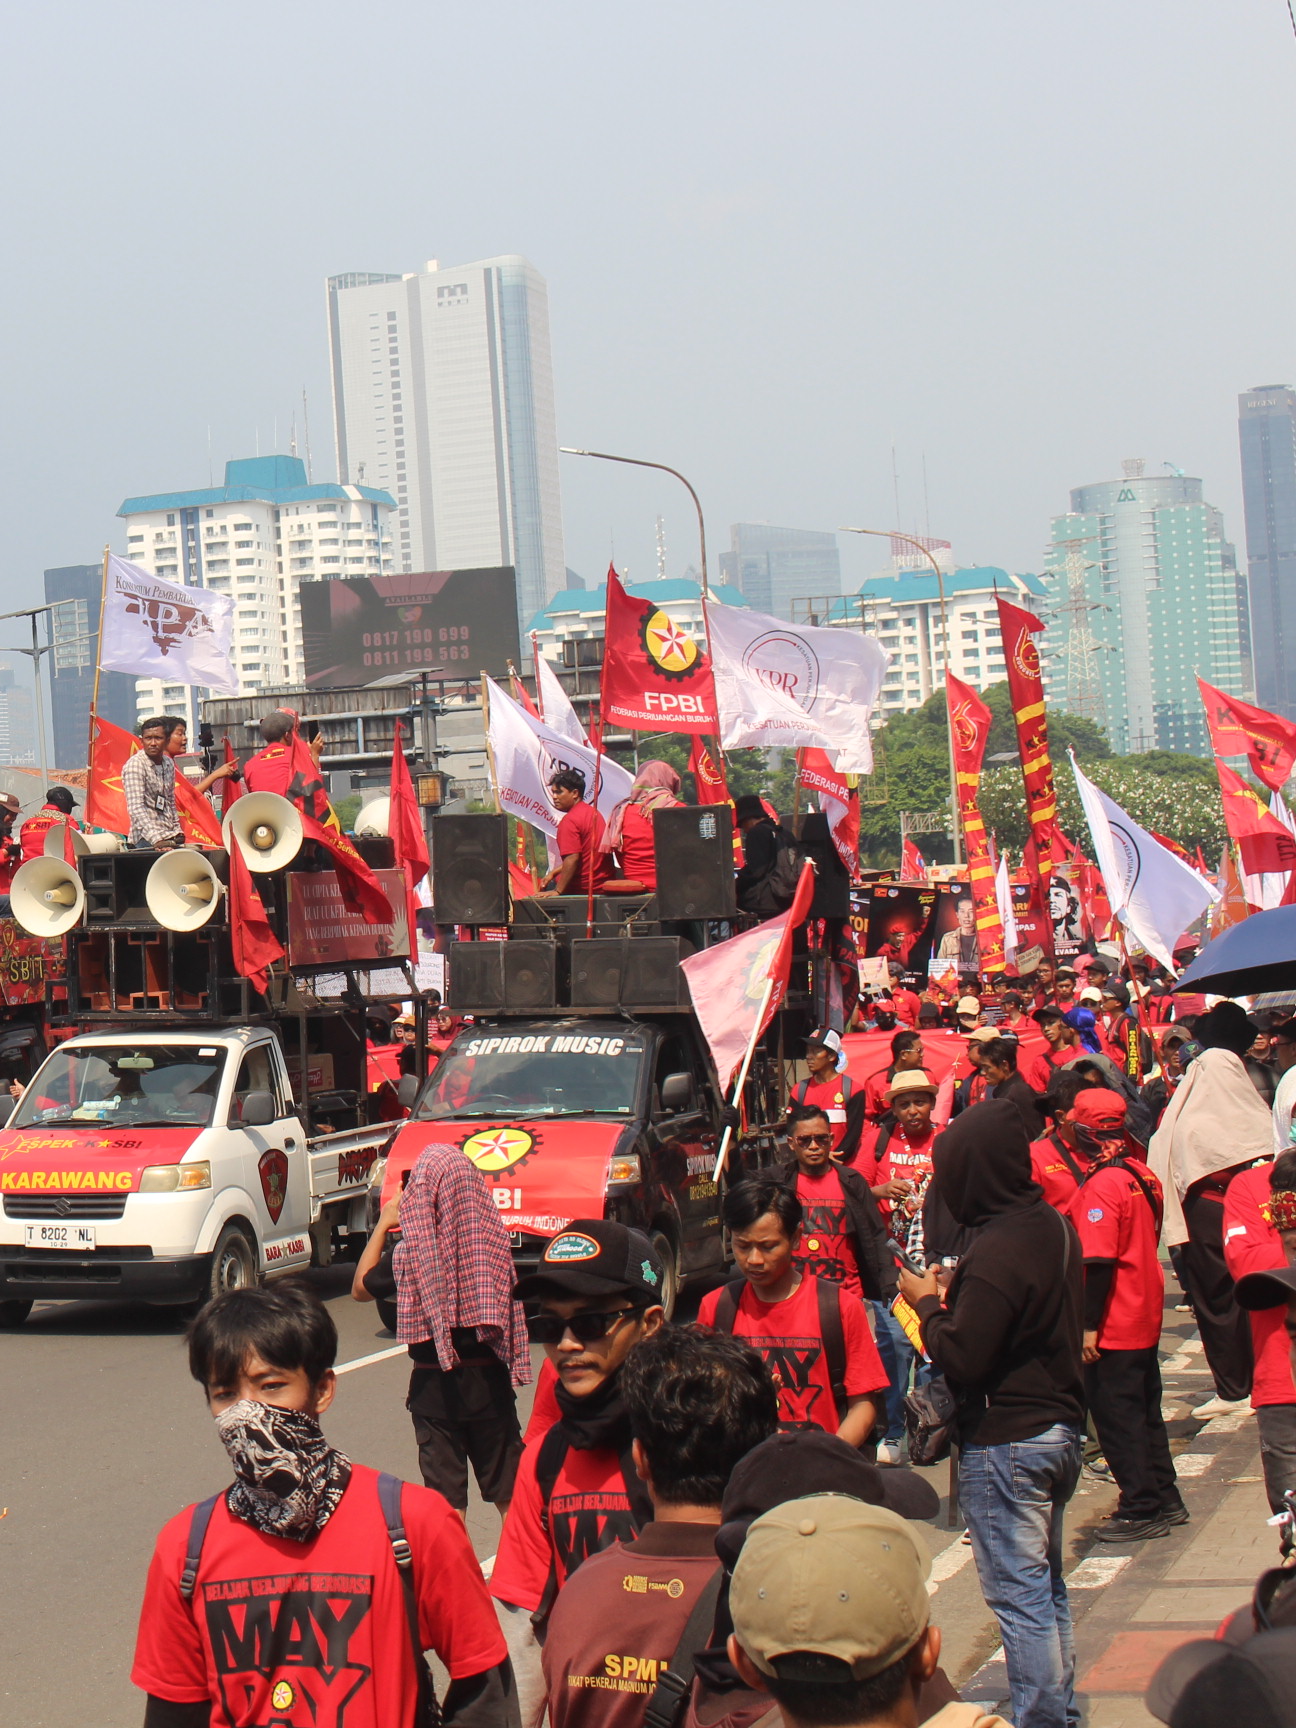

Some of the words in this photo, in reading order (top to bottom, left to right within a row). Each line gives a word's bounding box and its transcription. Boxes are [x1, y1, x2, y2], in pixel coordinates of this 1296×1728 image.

[386, 595, 432, 604] AVAILABLE
[363, 631, 399, 647] 0817
[405, 628, 433, 644] 190
[439, 626, 469, 641] 699
[363, 651, 399, 666] 0811
[405, 648, 433, 663] 199
[439, 645, 469, 660] 563
[754, 667, 799, 699] KPR
[644, 691, 705, 713] FPBI
[610, 705, 638, 718] FEDERASI
[638, 711, 685, 722] PERJUANGAN
[747, 719, 790, 730] KESATUAN
[800, 768, 839, 794] FEDERASI
[530, 802, 559, 828] PERJU
[329, 883, 343, 897] KER
[1055, 948, 1080, 956] EVARA
[465, 1036, 551, 1057] SIPIROK
[551, 1036, 624, 1056] MUSIC
[16, 1139, 78, 1150] FSPEK
[84, 1138, 143, 1149] KASBI
[1, 1171, 133, 1190] KARAWANG
[493, 1187, 522, 1209] BI
[802, 1205, 848, 1234] AY
[27, 1227, 34, 1240] T
[41, 1227, 67, 1241] 8202
[78, 1229, 93, 1242] NL
[264, 1246, 283, 1262] BARA
[287, 1239, 306, 1254] KASBI
[205, 1580, 251, 1602] BELAJAR
[251, 1575, 309, 1596] BERJUANG
[310, 1575, 371, 1595] BERKUASA
[204, 1596, 373, 1680] MAY
[568, 1675, 584, 1687] RIKAT
[584, 1676, 617, 1690] PEKERJA
[618, 1679, 647, 1694] MAGNUM
